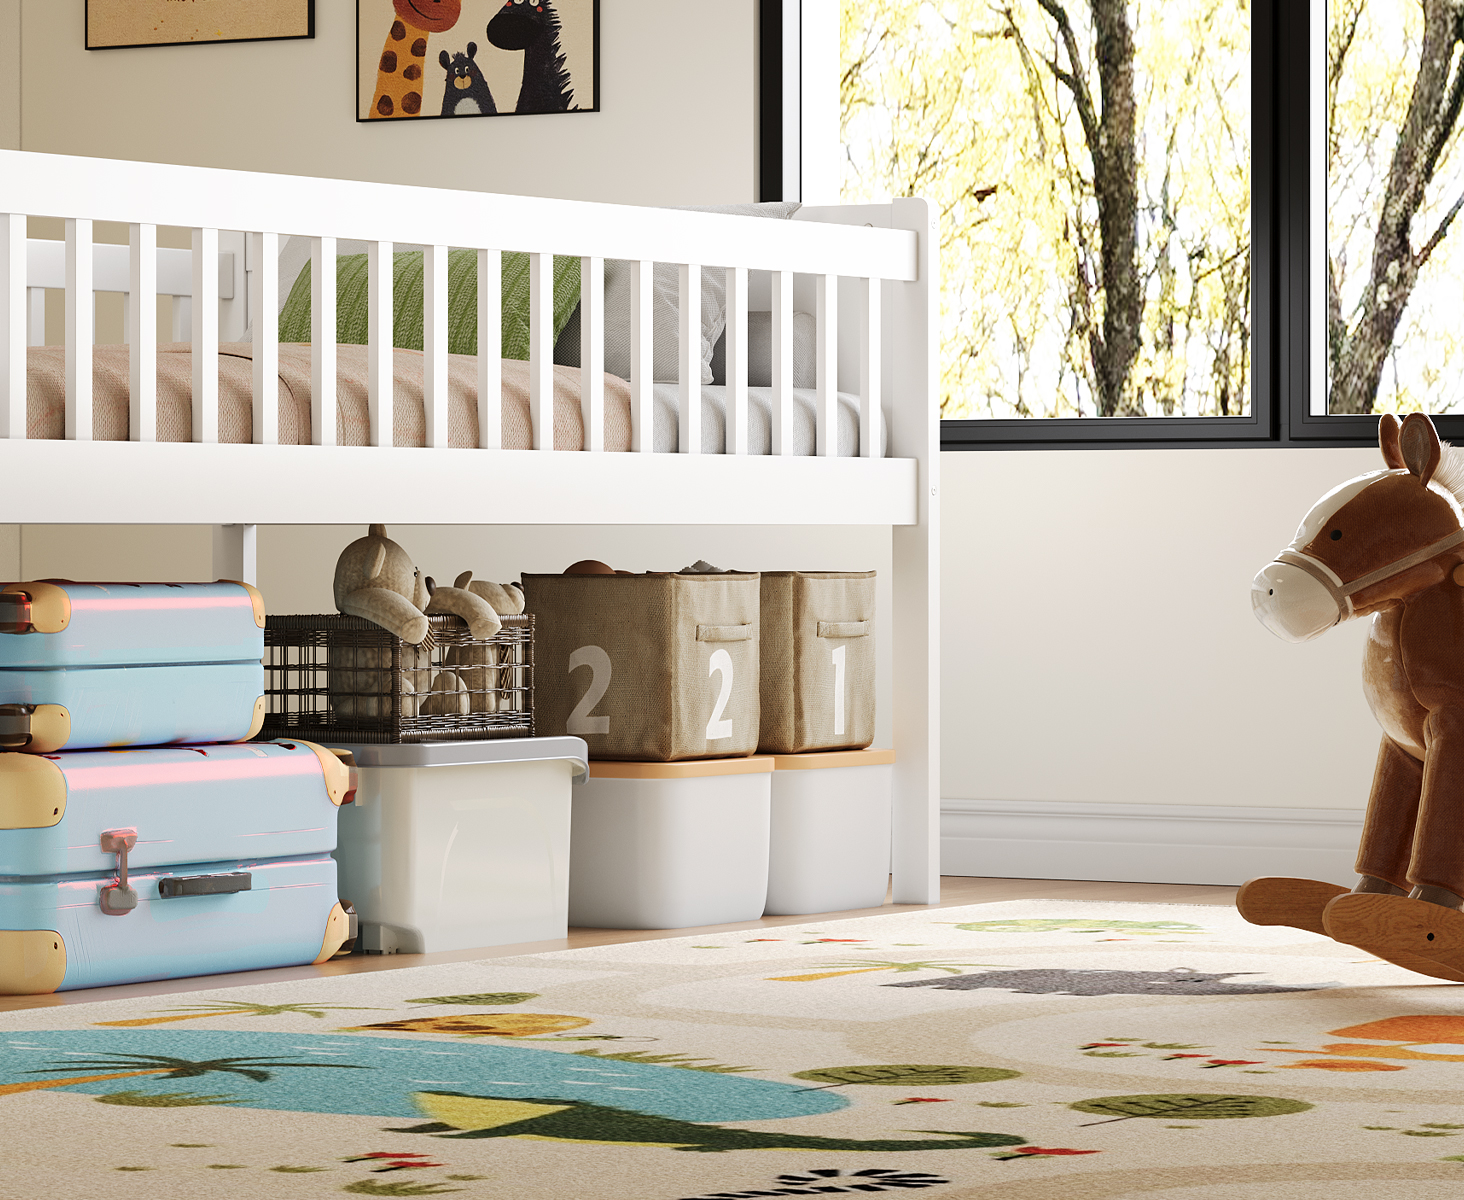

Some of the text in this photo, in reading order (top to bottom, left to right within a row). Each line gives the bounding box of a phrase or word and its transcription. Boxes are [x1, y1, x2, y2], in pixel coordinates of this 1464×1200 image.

[566, 645, 612, 735] 2
[706, 648, 734, 740] 2
[831, 645, 846, 735] 1
